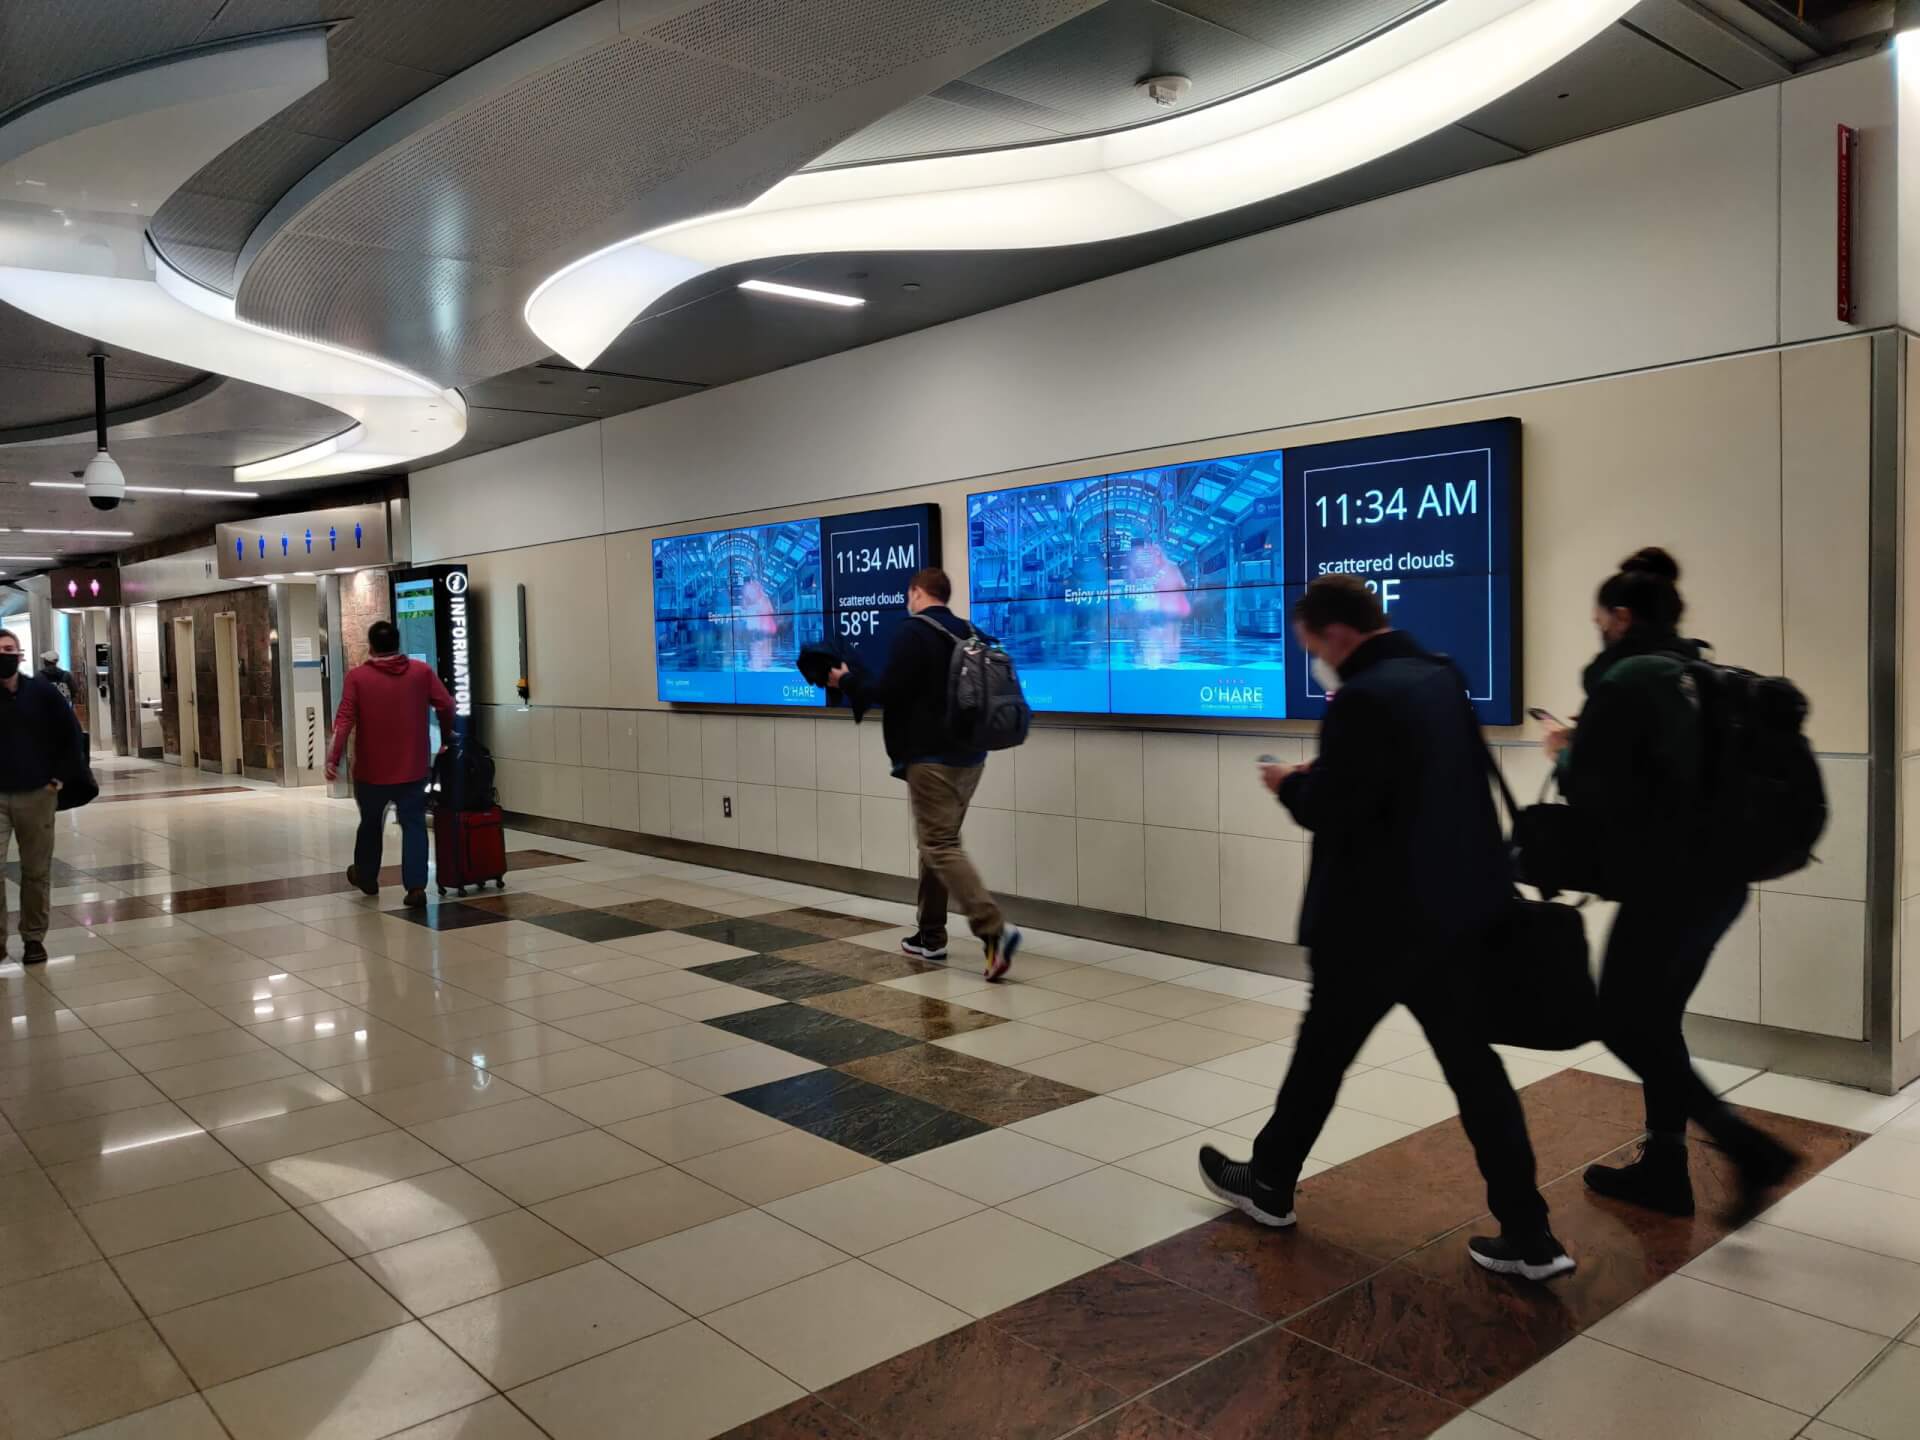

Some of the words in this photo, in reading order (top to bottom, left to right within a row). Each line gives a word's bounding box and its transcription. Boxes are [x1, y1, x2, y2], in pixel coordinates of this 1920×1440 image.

[1315, 487, 1408, 528] 11:34
[1417, 479, 1478, 519] AM
[836, 549, 882, 574] 11:34
[886, 544, 915, 570] AM
[1318, 554, 1393, 575] scattered
[1398, 550, 1454, 571] clouds
[839, 593, 876, 606] scattered
[877, 592, 905, 605] clouds
[1064, 588, 1094, 605] Enjoy
[1096, 587, 1121, 604] your
[840, 610, 880, 636] 58°F
[450, 597, 471, 716] INFORMATION
[782, 685, 815, 698] O'HARE
[1200, 685, 1264, 703] O'HARE
